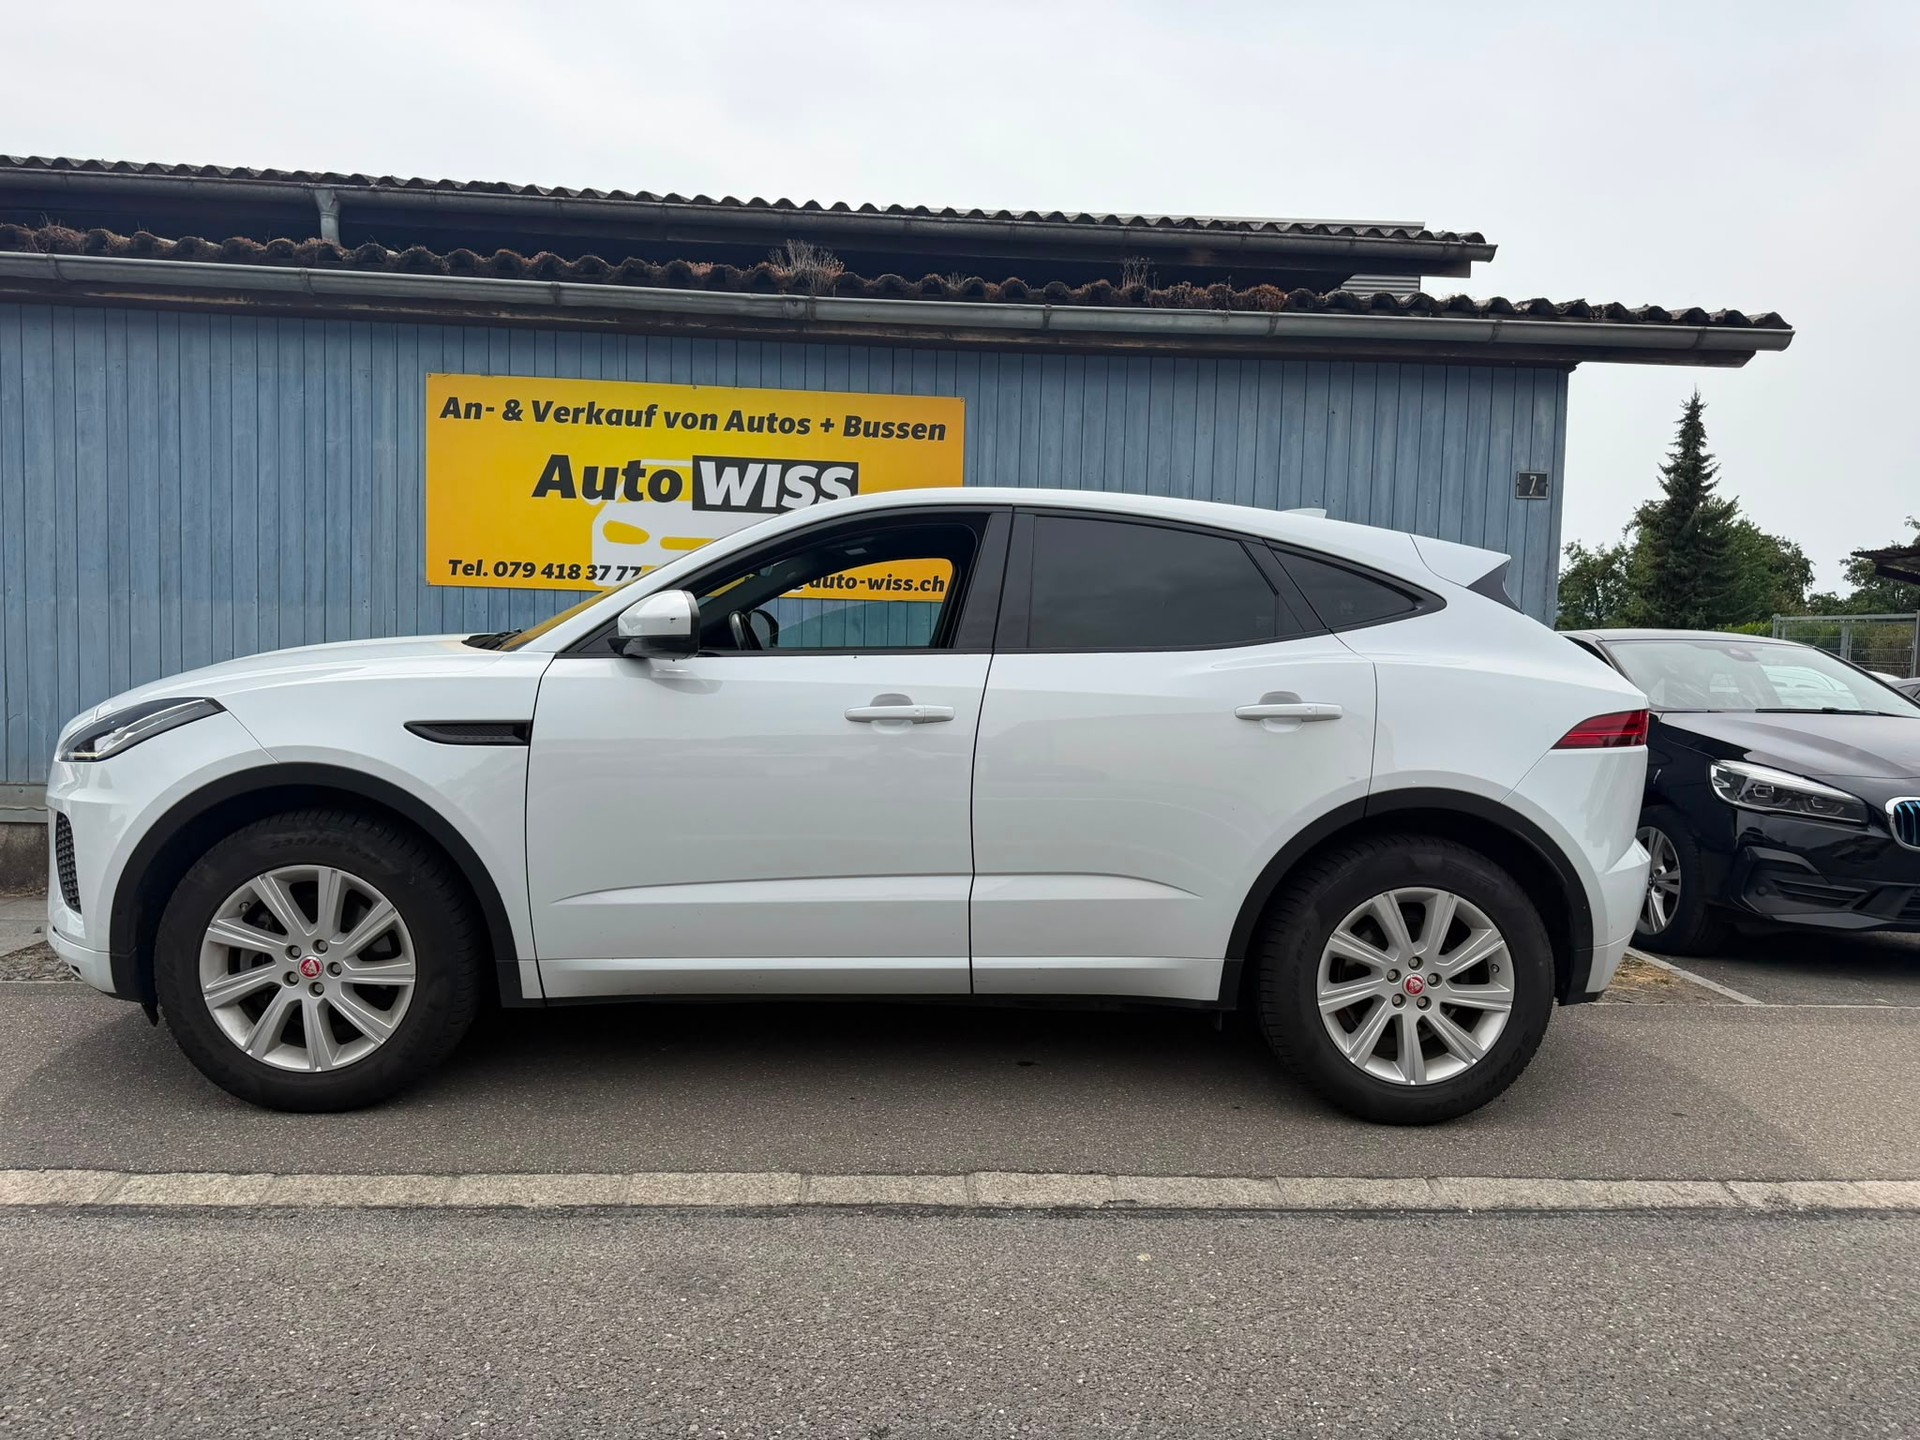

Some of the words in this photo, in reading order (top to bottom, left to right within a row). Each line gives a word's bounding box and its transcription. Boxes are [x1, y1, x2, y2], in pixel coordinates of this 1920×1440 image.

[440, 397, 495, 419] An-
[502, 399, 524, 422] &
[531, 400, 659, 428] Verkauf
[664, 410, 718, 431] von
[724, 410, 811, 435] Autos
[819, 417, 835, 433] +
[843, 415, 947, 441] Bussen
[531, 454, 683, 503] Auto
[699, 460, 854, 510] WISS
[1529, 475, 1537, 495] 7
[448, 559, 489, 577] Tel.
[493, 561, 536, 579] 079
[541, 563, 582, 581] 418
[585, 564, 612, 582] 37
[615, 565, 643, 582] 77
